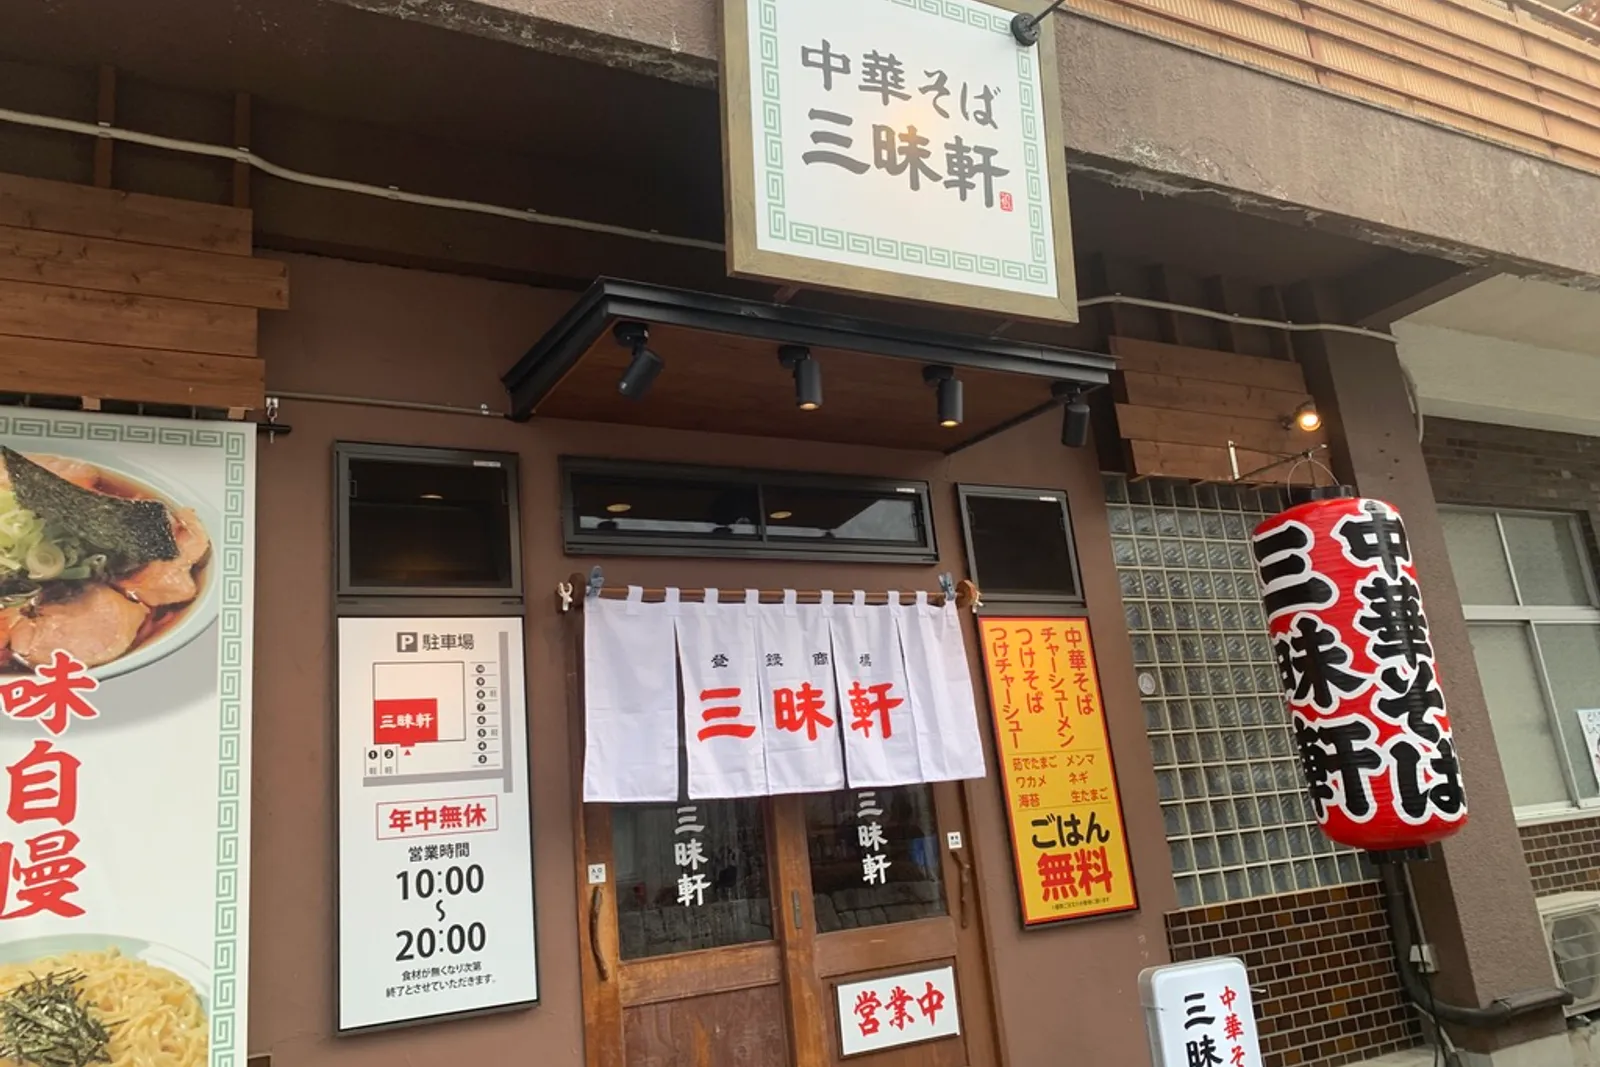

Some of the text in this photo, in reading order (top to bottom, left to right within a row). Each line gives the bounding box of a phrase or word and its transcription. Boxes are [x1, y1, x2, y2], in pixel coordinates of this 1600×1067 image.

[801, 39, 1001, 129] 中華そば
[801, 108, 1010, 208] 三昧軒
[422, 633, 475, 650] 駐車場
[1015, 628, 1044, 714] つけそば
[1064, 626, 1094, 716] 中華そば
[1340, 509, 1465, 818] 中華そば
[989, 627, 1023, 749] つけチャーシュー
[1040, 627, 1075, 748] チャーシューメン
[1066, 754, 1095, 767] メンマ
[1069, 770, 1088, 784] ネギ
[0, 651, 97, 919] 味自慢
[1016, 775, 1046, 788] ワカメ
[1070, 787, 1108, 803] 生たまご
[389, 803, 487, 832] 年中無休
[1031, 812, 1110, 849] ごはん
[408, 842, 470, 862] 営業時間
[396, 864, 484, 900] 10:00
[1037, 846, 1113, 902] 無料
[395, 922, 486, 961] 20:00
[402, 961, 482, 981] 食材が無くなり次第
[854, 982, 945, 1037] 営業中
